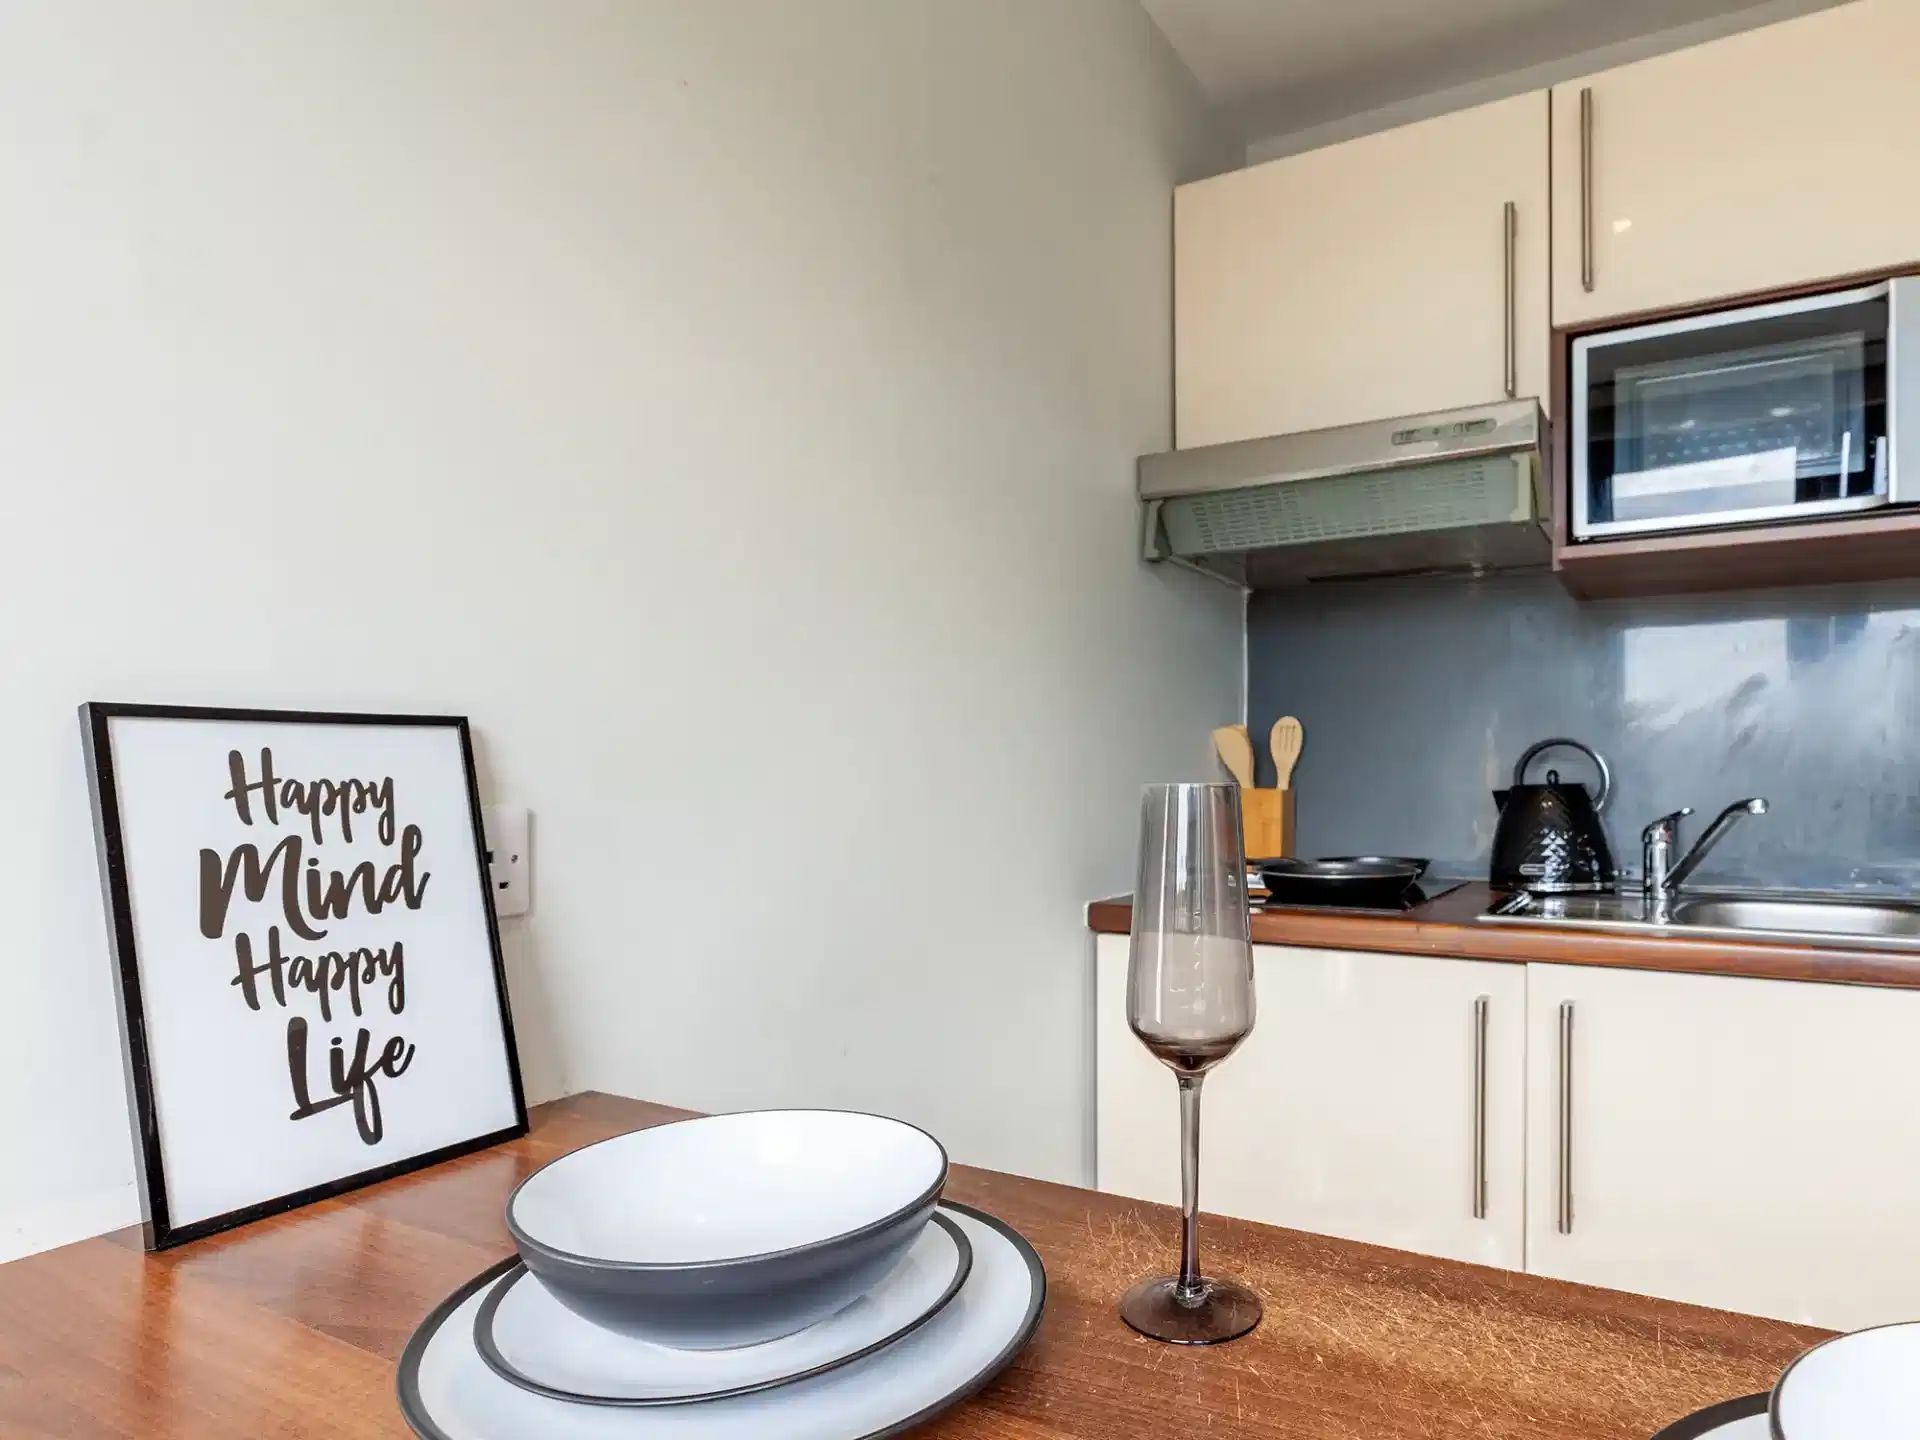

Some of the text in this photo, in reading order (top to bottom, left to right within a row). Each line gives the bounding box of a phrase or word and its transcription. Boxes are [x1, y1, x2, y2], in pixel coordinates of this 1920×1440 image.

[224, 747, 396, 846] Happy
[199, 823, 431, 941] Mind
[230, 925, 405, 1023] Happy
[287, 1016, 416, 1146] Life
